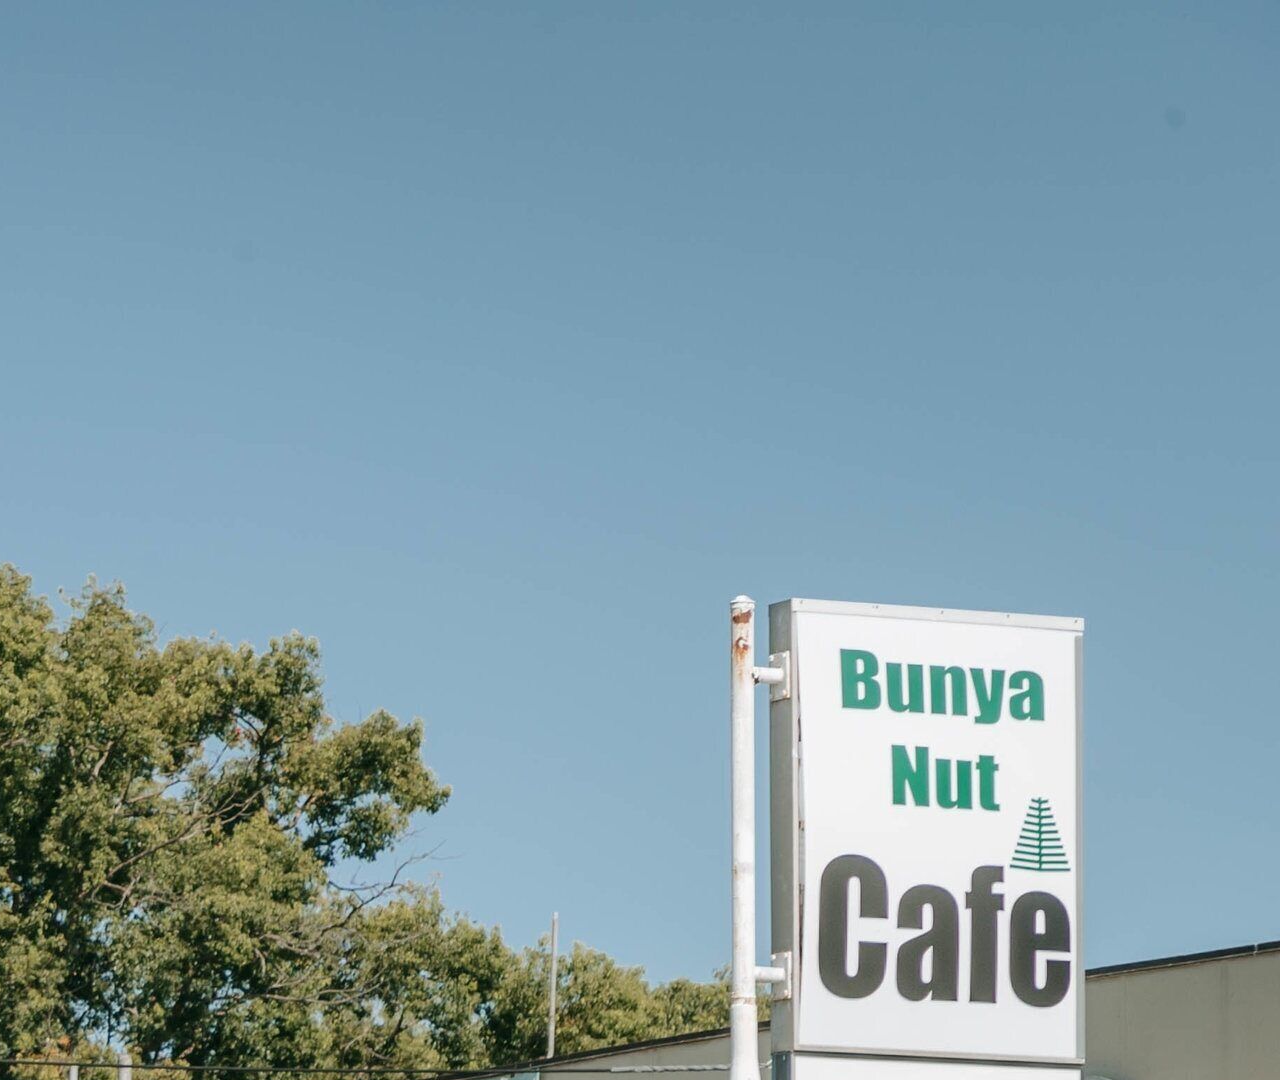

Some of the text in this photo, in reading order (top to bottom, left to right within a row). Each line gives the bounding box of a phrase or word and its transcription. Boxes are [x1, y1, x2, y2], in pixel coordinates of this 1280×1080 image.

[840, 648, 1046, 724] Bunya
[892, 745, 1000, 811] Nut
[819, 854, 1071, 1008] Cafe
